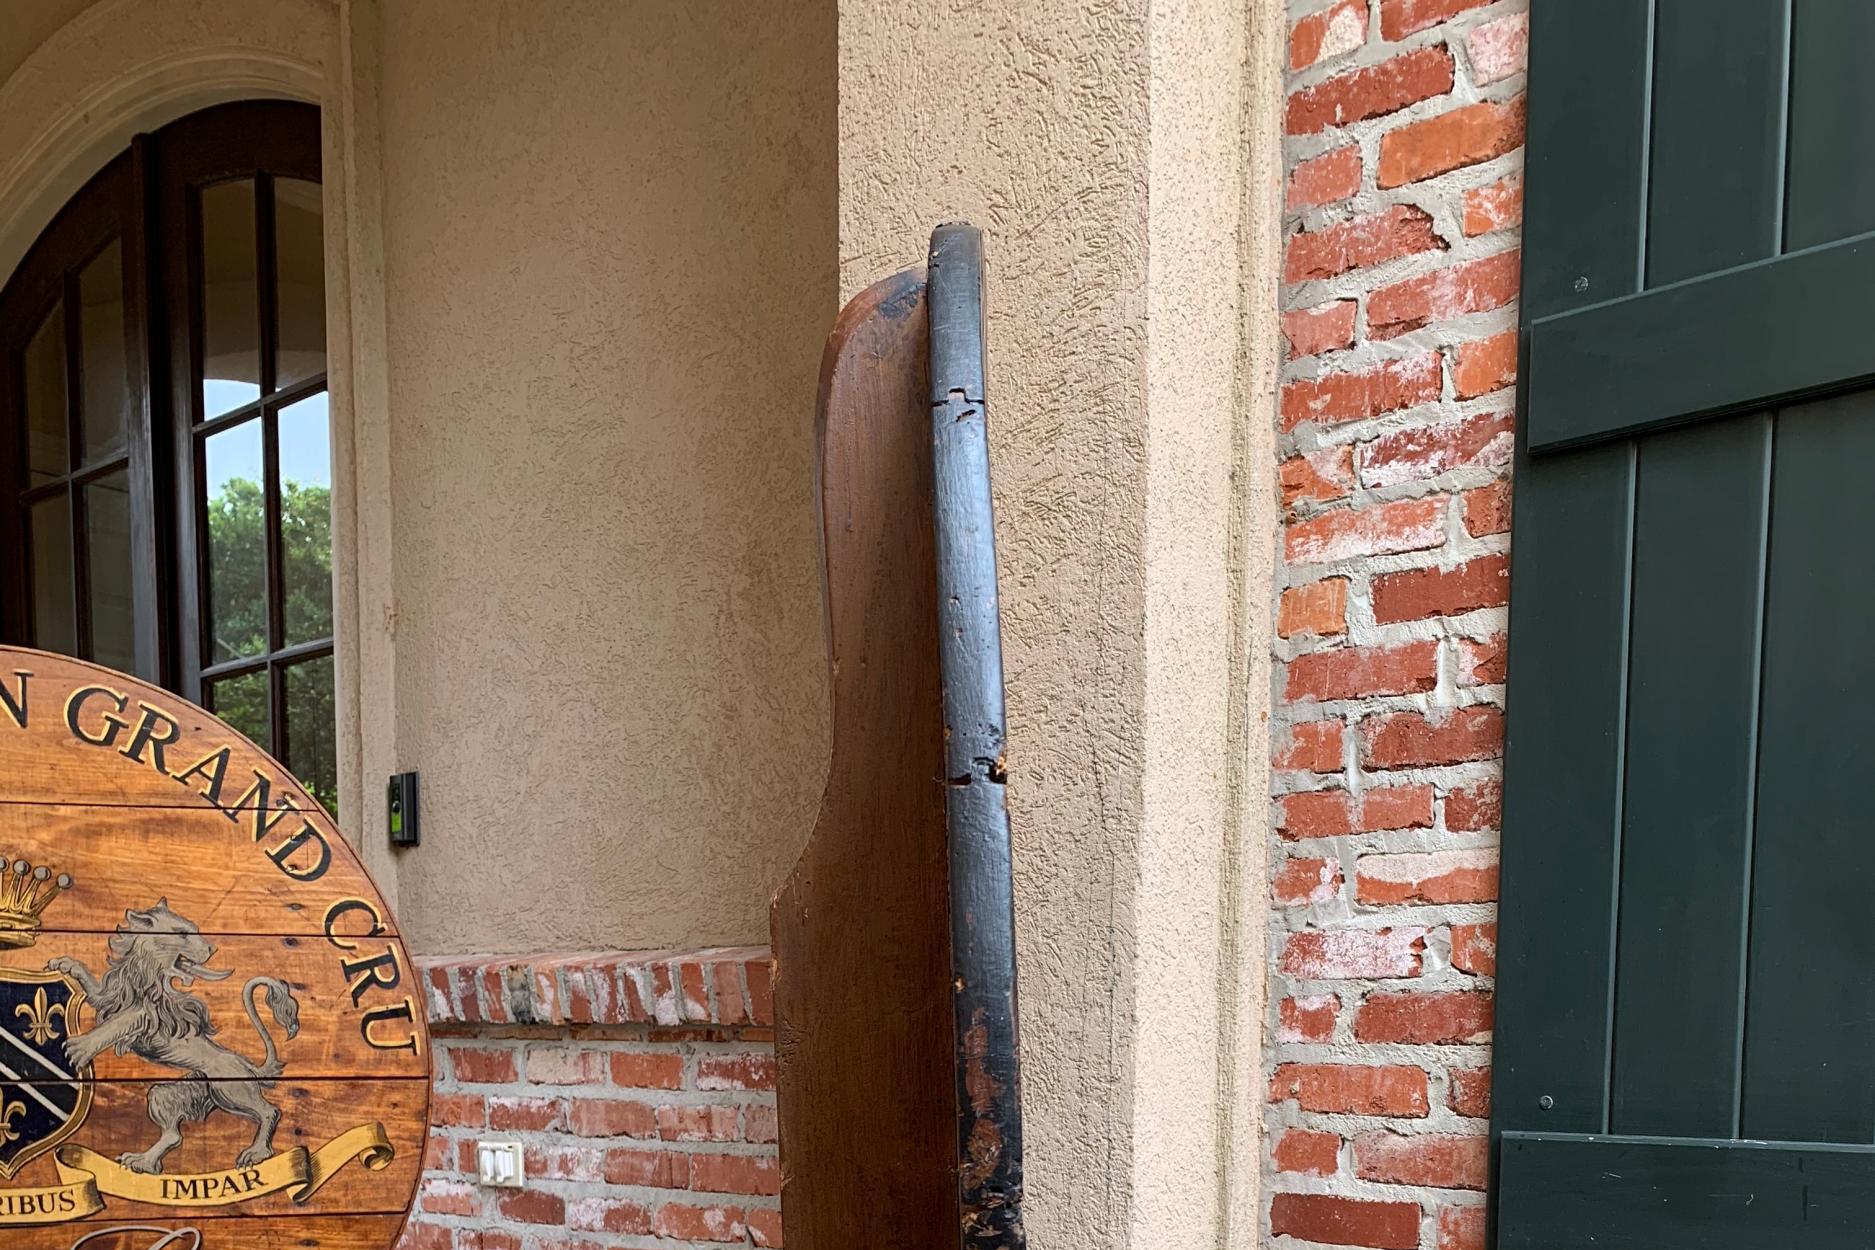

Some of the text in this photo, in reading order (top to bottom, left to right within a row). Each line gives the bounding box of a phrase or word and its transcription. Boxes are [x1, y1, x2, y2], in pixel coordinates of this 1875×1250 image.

[64, 683, 333, 882] GRAND
[322, 896, 421, 1056] CRU
[160, 1167, 268, 1200] IMPAR
